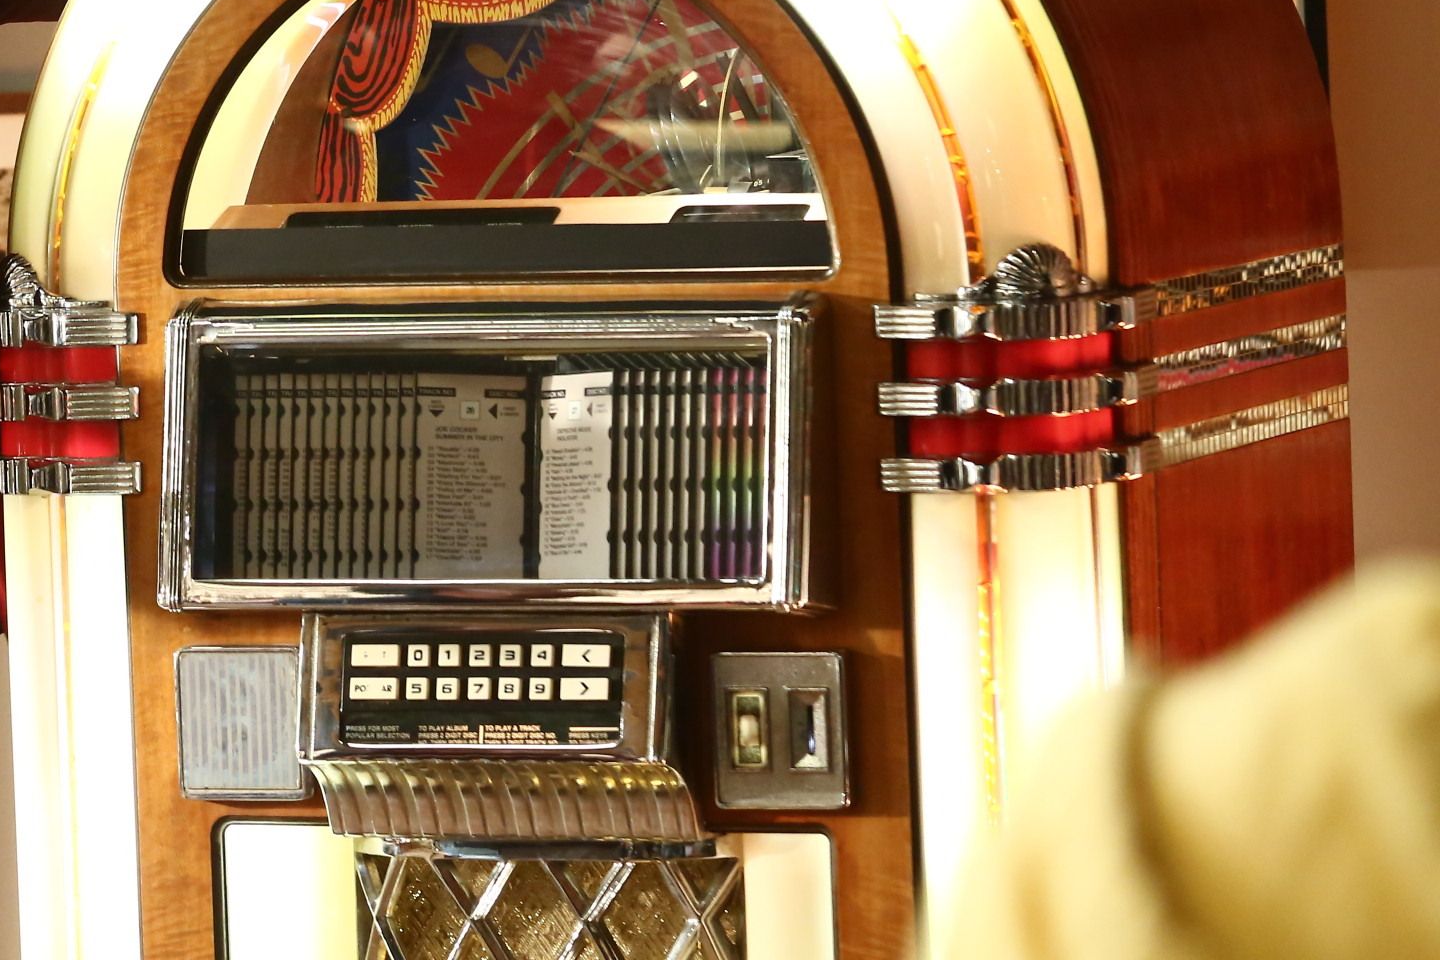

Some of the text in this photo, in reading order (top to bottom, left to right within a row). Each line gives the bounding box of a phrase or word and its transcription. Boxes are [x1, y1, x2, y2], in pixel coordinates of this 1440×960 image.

[413, 649, 547, 661] 0 1 2 3 4
[411, 683, 422, 693] 5
[442, 683, 452, 693] 6
[473, 683, 484, 693] 7
[504, 683, 514, 693] 8
[535, 683, 545, 693] 9
